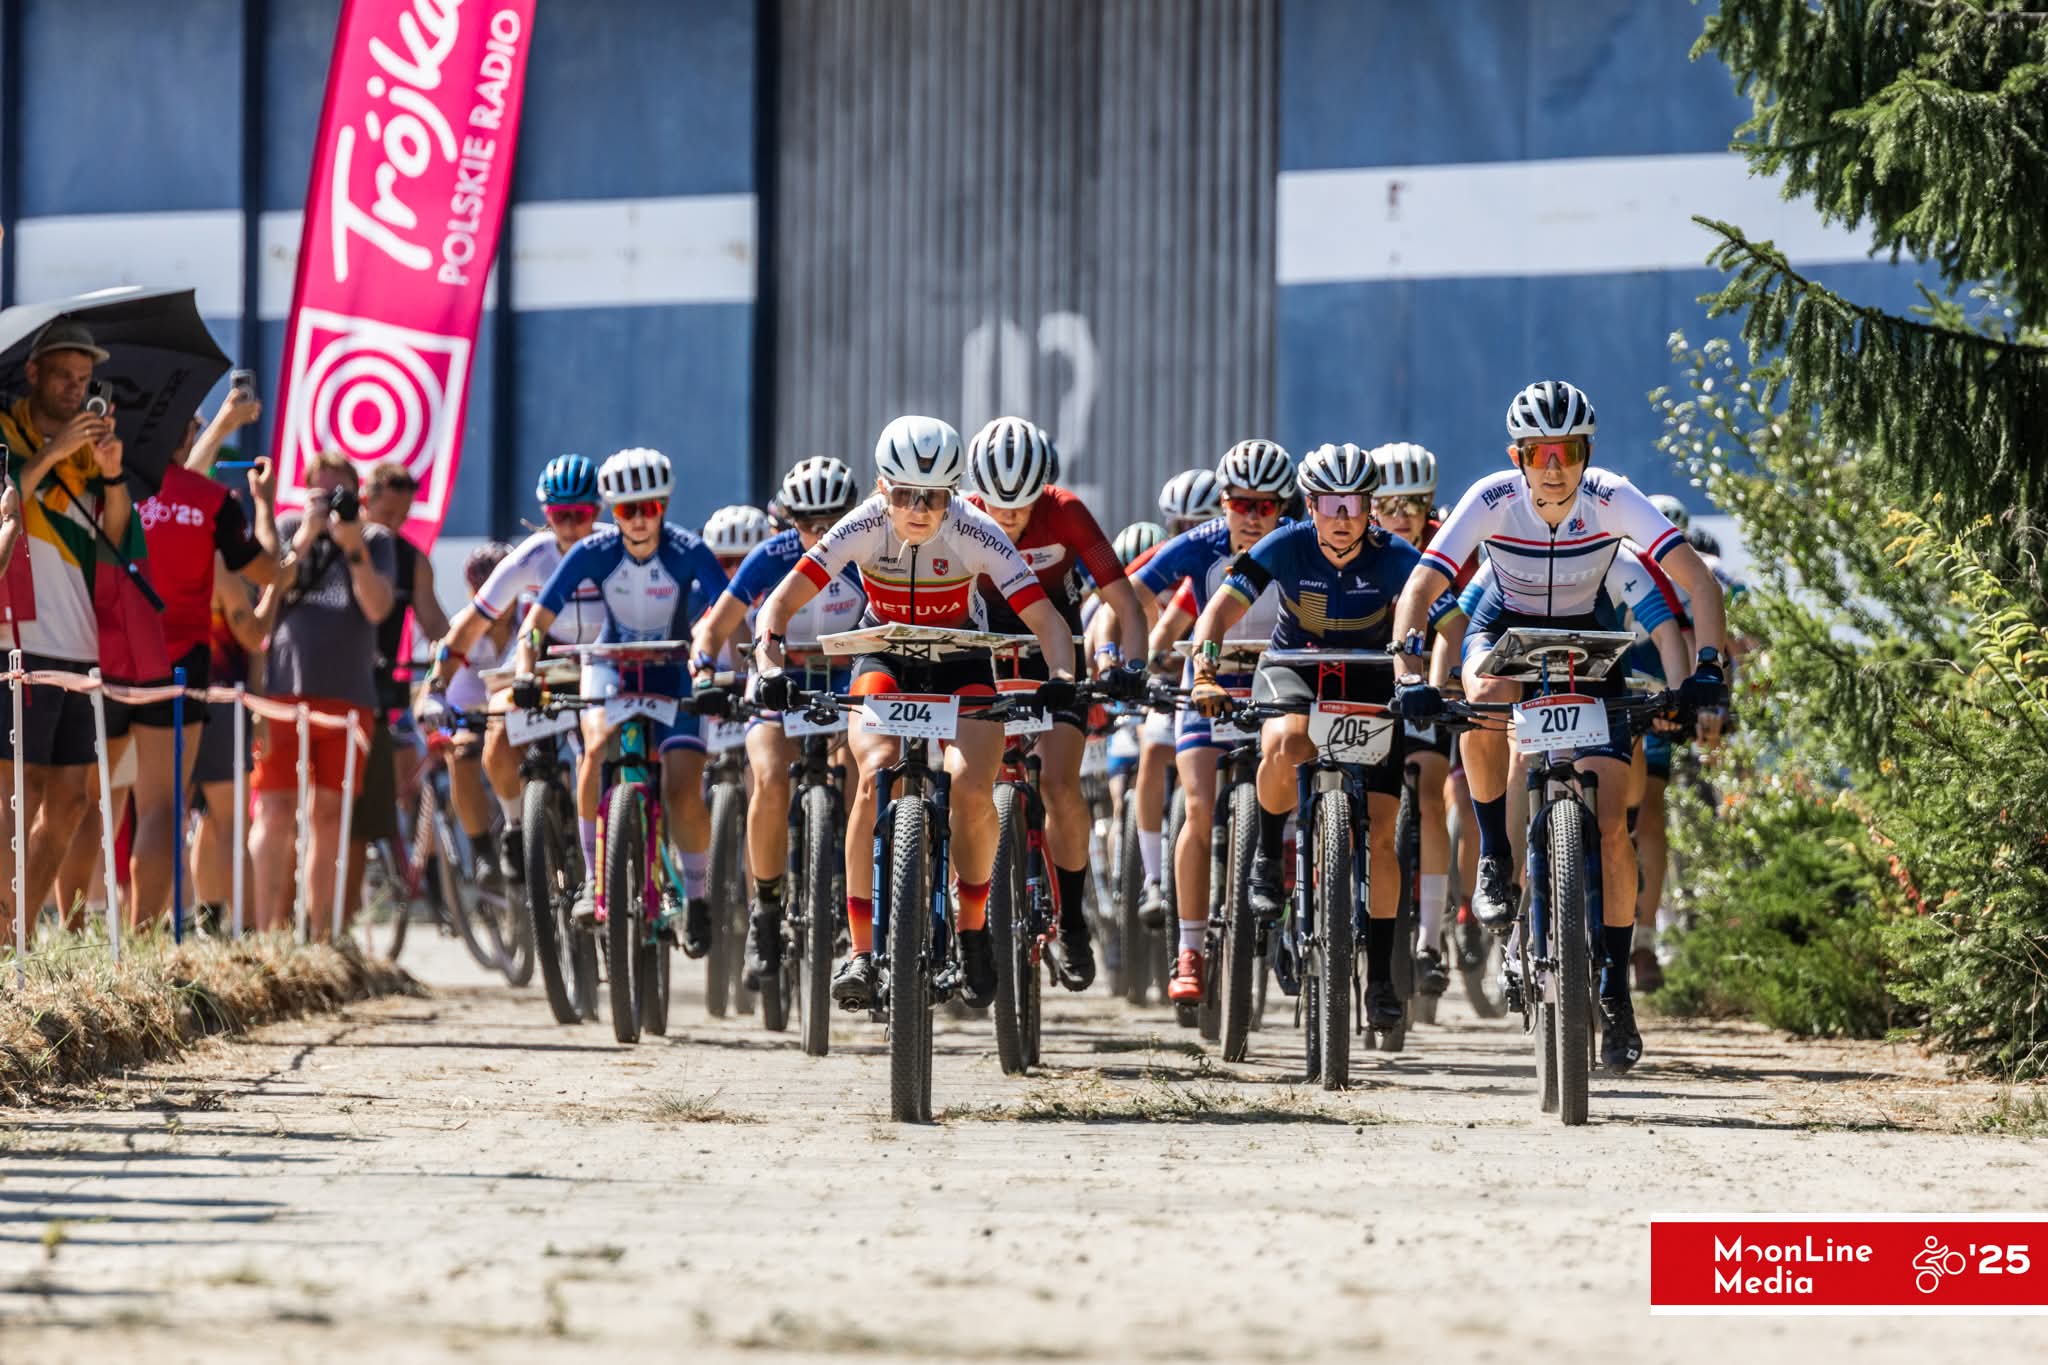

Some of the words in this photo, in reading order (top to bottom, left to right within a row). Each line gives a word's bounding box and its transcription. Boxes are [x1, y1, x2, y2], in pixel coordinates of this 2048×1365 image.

[437, 135, 496, 286] POLSKIE
[469, 9, 521, 130] RADIO
[1481, 482, 1515, 506] FRANCE
[875, 599, 961, 616] IETUVA
[888, 702, 932, 723] 204
[1539, 706, 1581, 733] 207
[1331, 716, 1370, 747] 205
